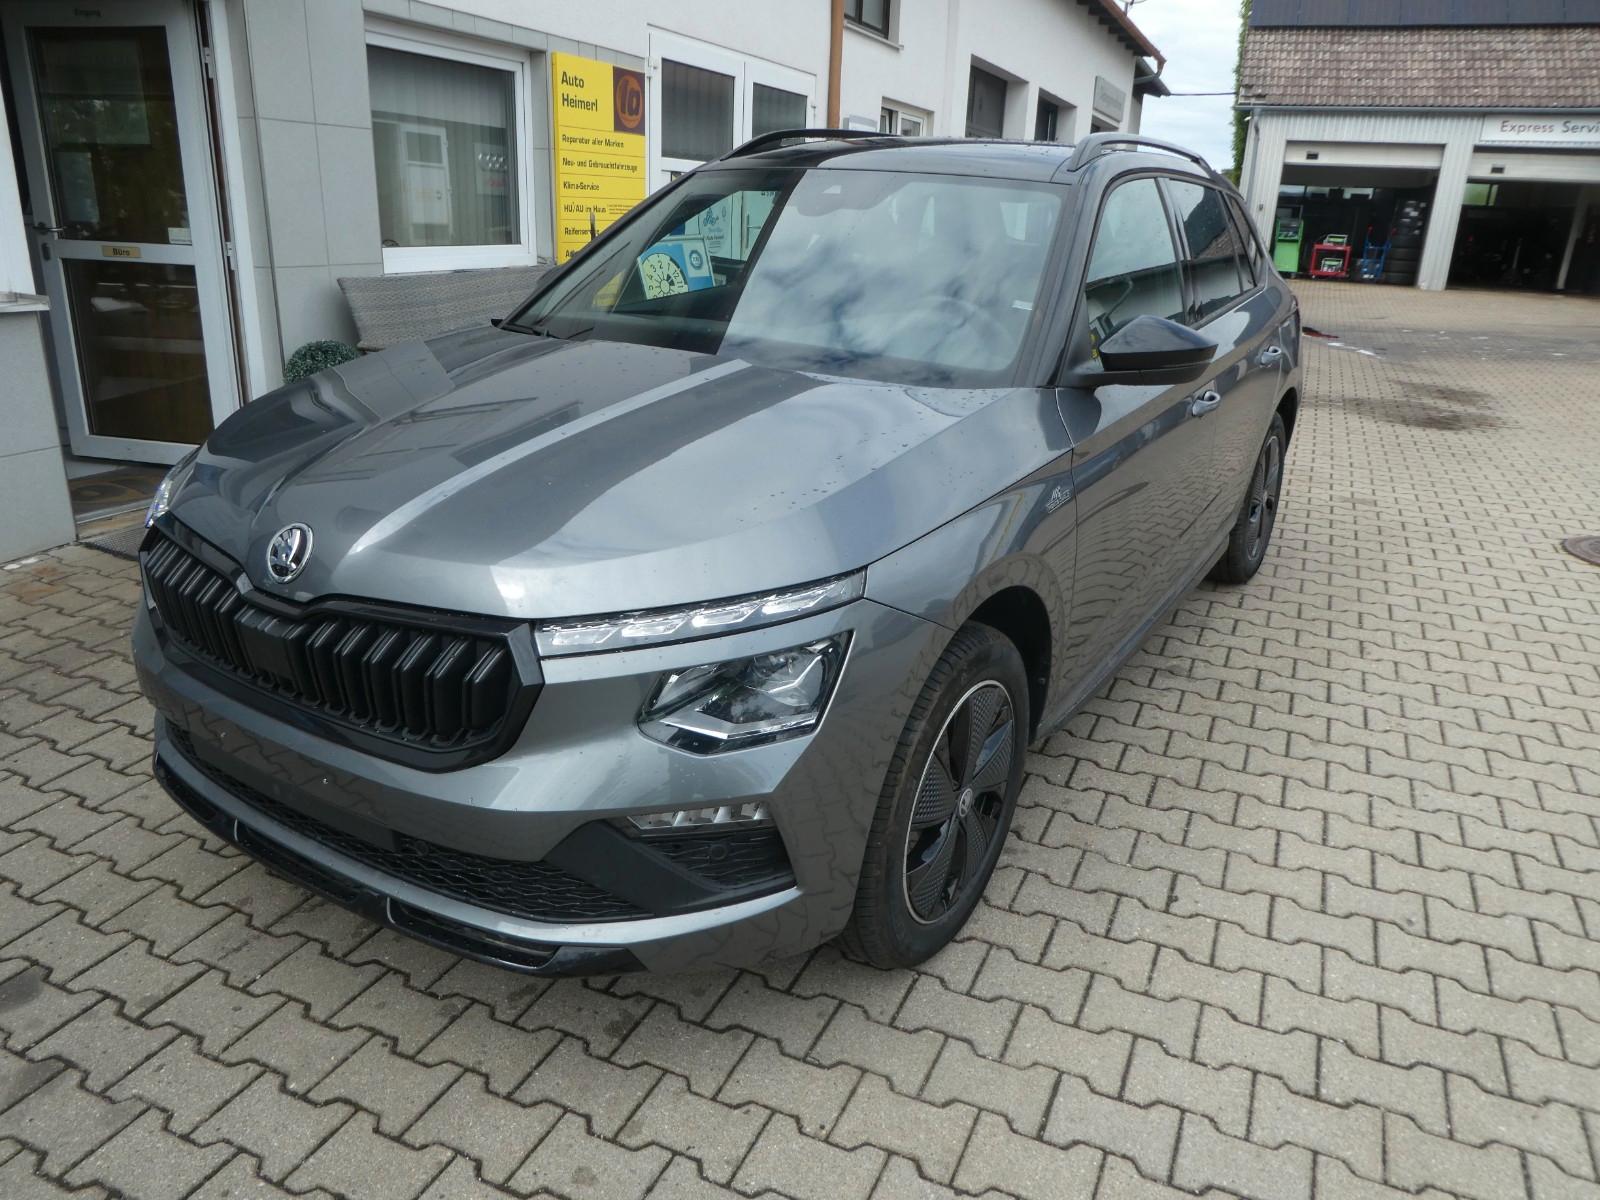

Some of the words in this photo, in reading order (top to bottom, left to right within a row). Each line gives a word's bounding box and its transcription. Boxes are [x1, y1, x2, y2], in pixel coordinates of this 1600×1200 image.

[561, 71, 585, 88] Auto
[561, 93, 598, 112] Heimerl
[1500, 120, 1555, 134] Express
[562, 134, 591, 145] Reparatur
[591, 138, 604, 146] aller
[577, 159, 587, 168] und
[563, 181, 600, 191] Klima-Service
[564, 227, 600, 236] Reifenser
